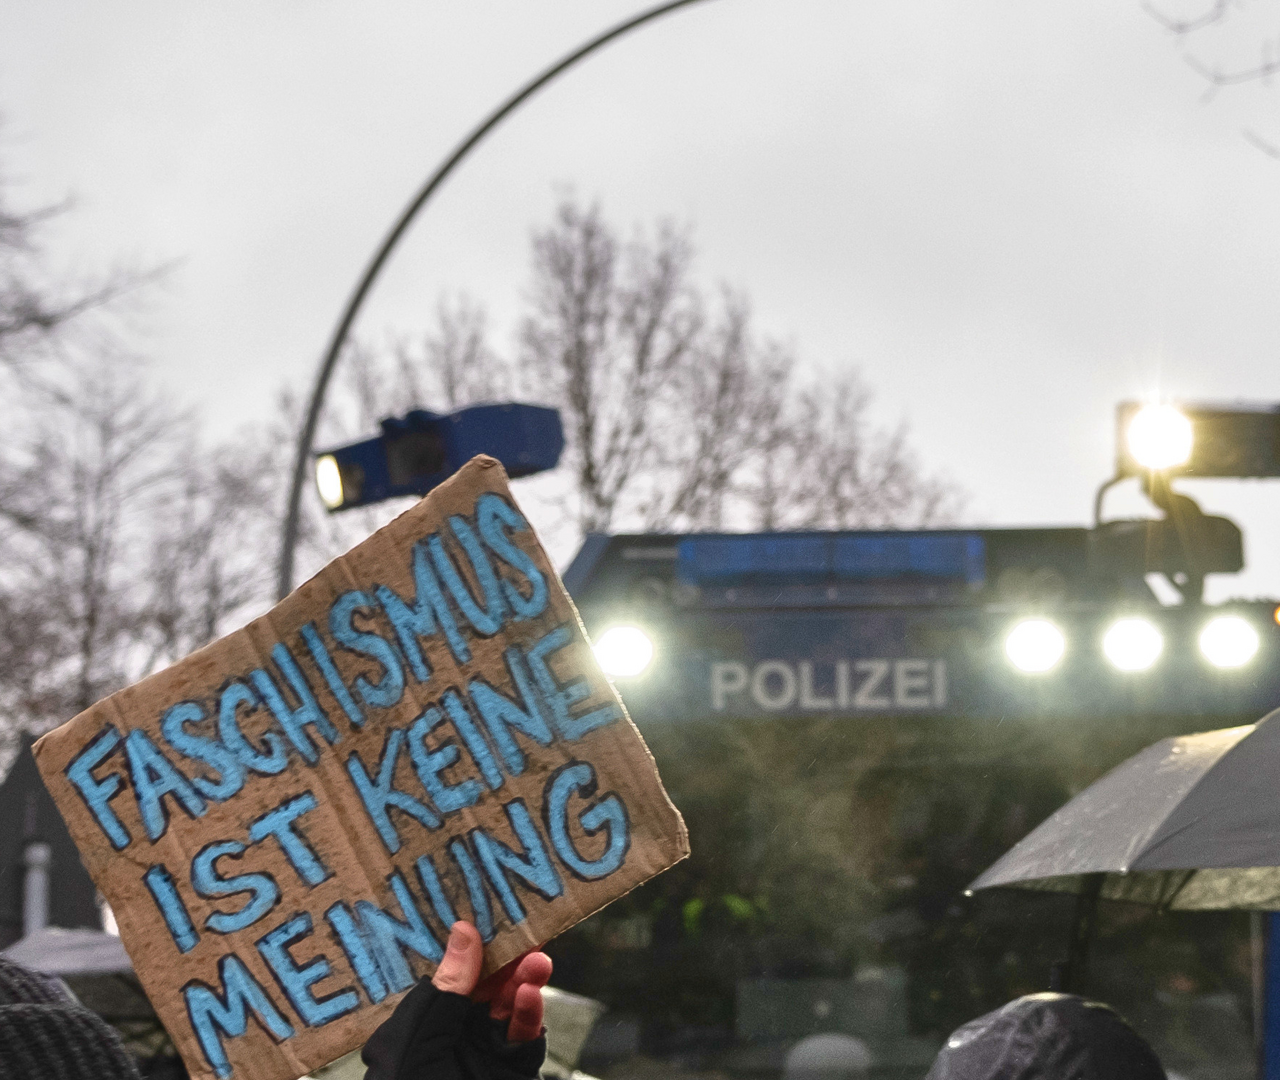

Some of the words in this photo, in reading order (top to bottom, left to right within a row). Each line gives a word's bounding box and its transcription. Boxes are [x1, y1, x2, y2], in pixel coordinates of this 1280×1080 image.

[66, 491, 550, 851] FASCHISMUS
[143, 790, 335, 953] IST
[344, 624, 619, 856] KEINE
[711, 659, 948, 710] POLIZEI
[181, 760, 632, 1080] MEINUNG
